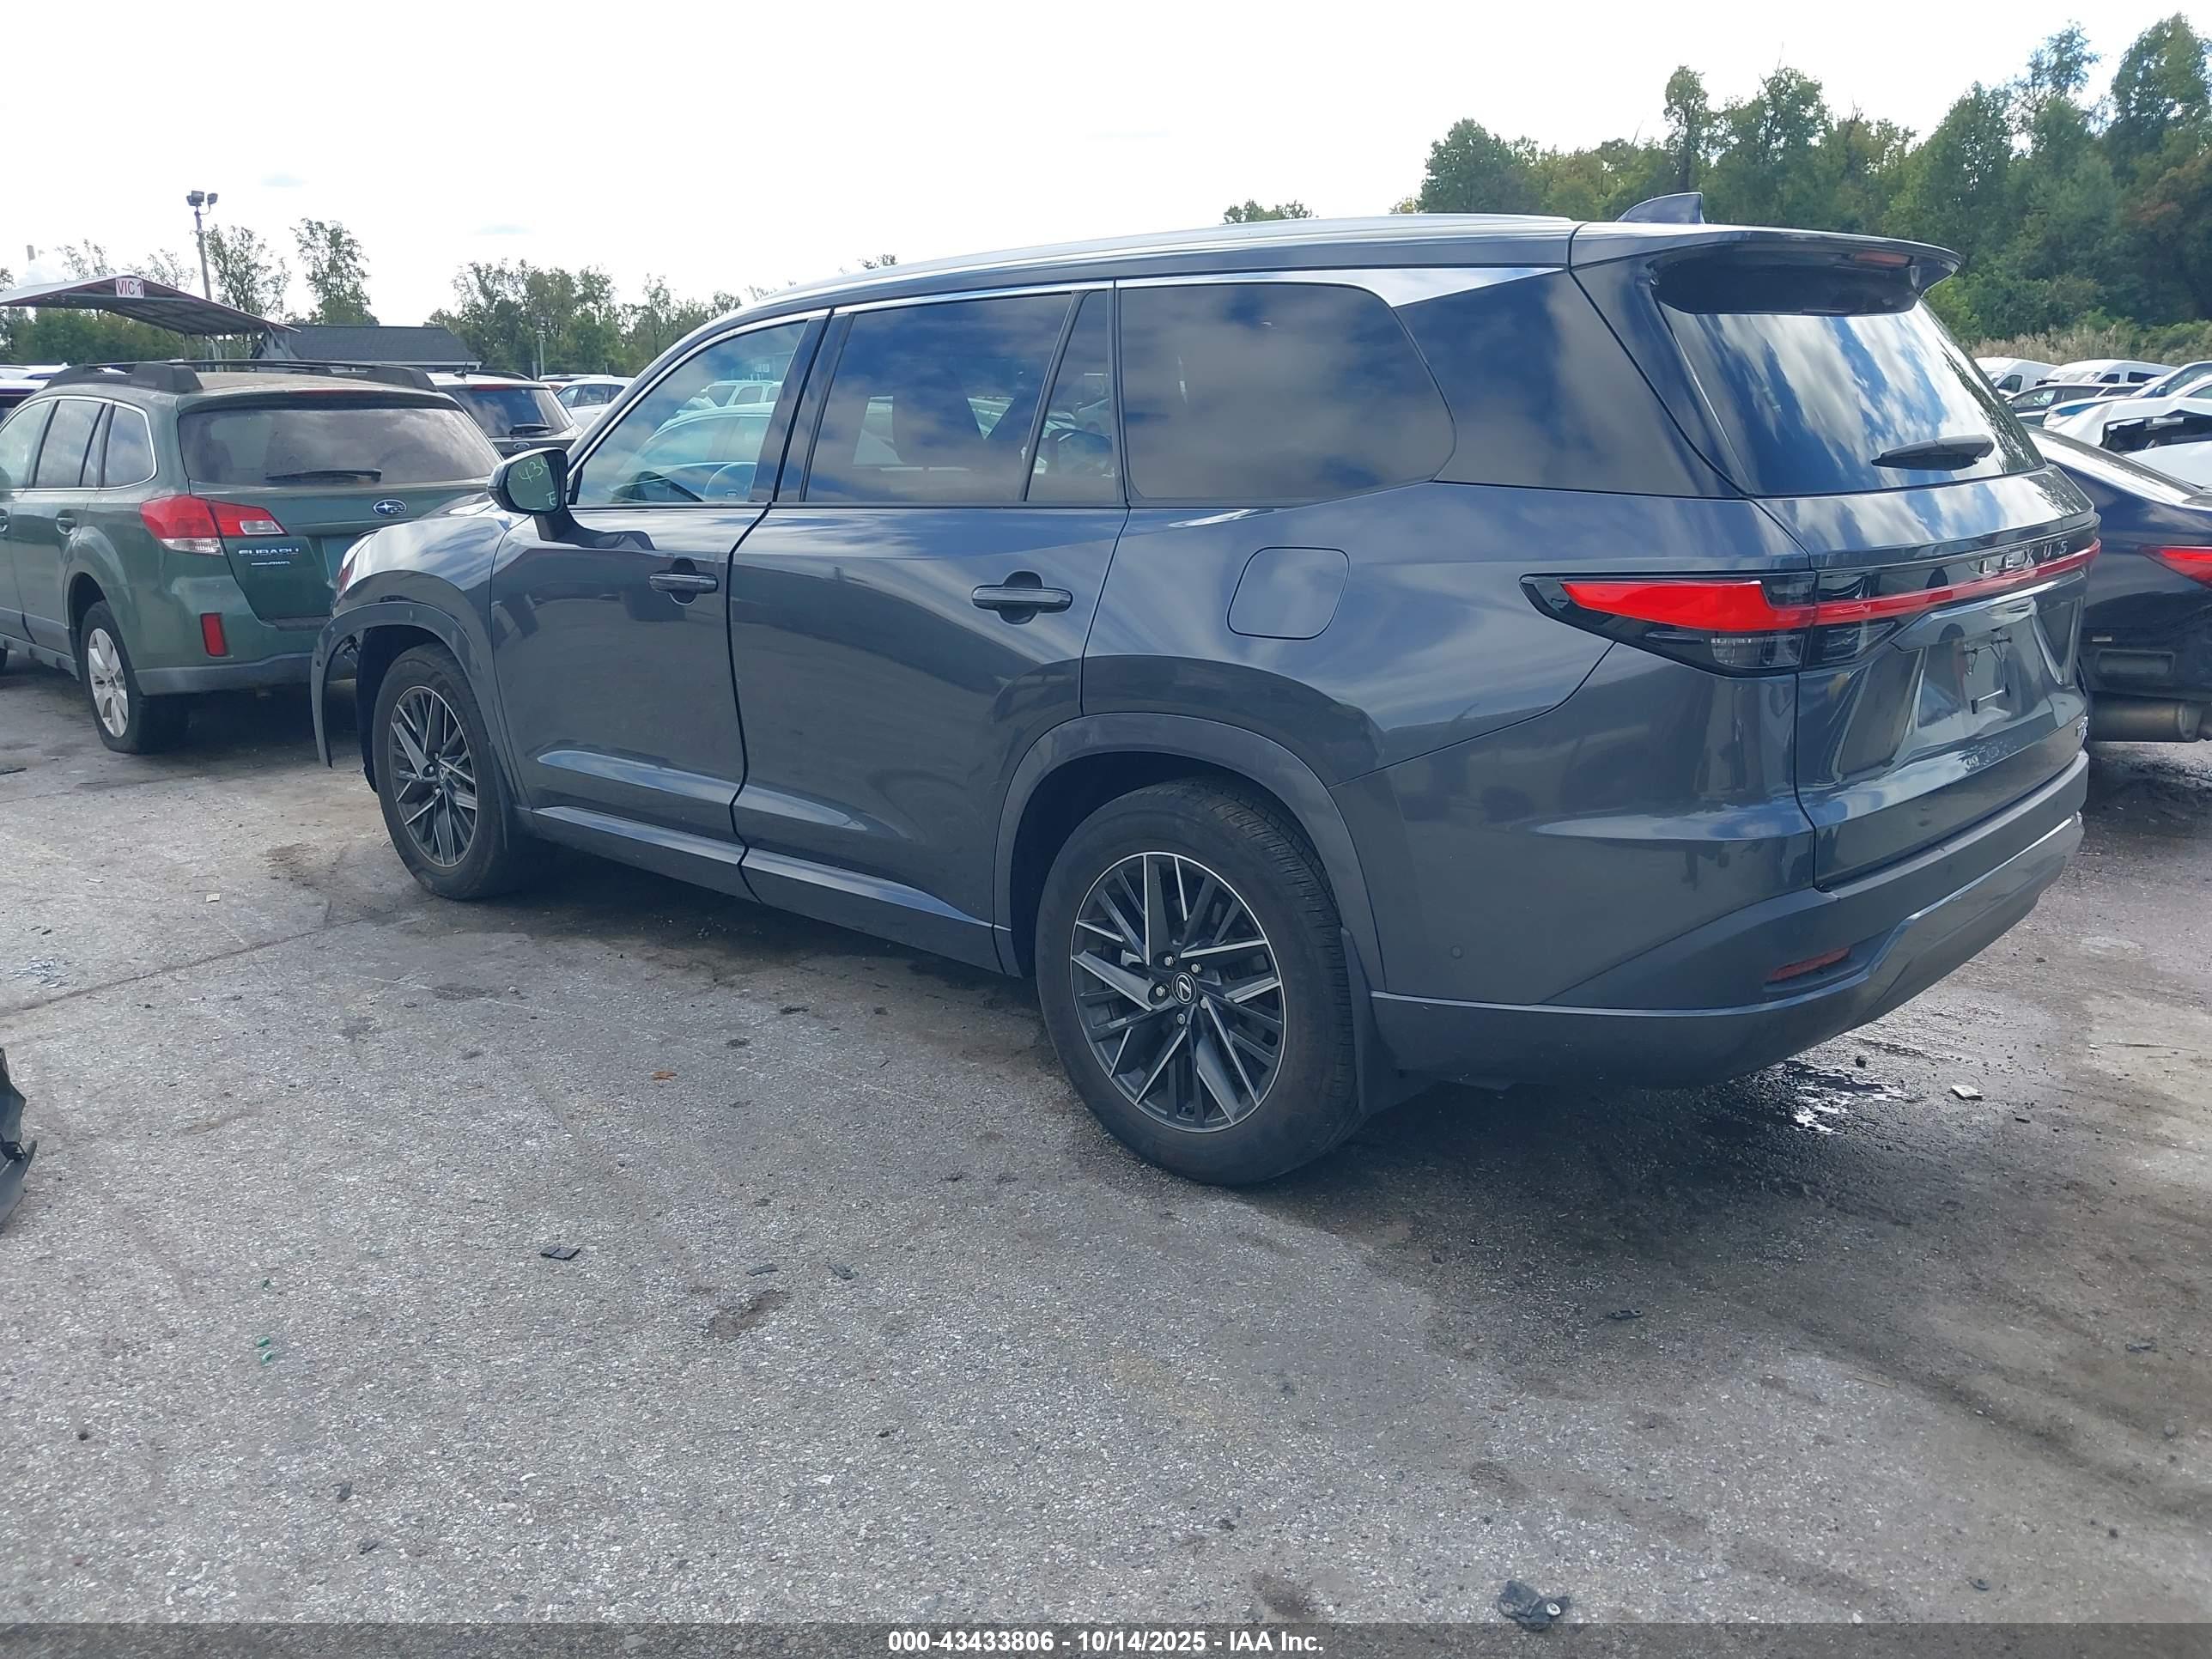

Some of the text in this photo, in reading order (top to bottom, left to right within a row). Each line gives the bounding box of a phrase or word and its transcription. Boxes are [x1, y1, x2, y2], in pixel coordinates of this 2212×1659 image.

[117, 280, 143, 296] VIC 1
[238, 547, 300, 556] SUBARU
[1984, 540, 2069, 574] LEXUS
